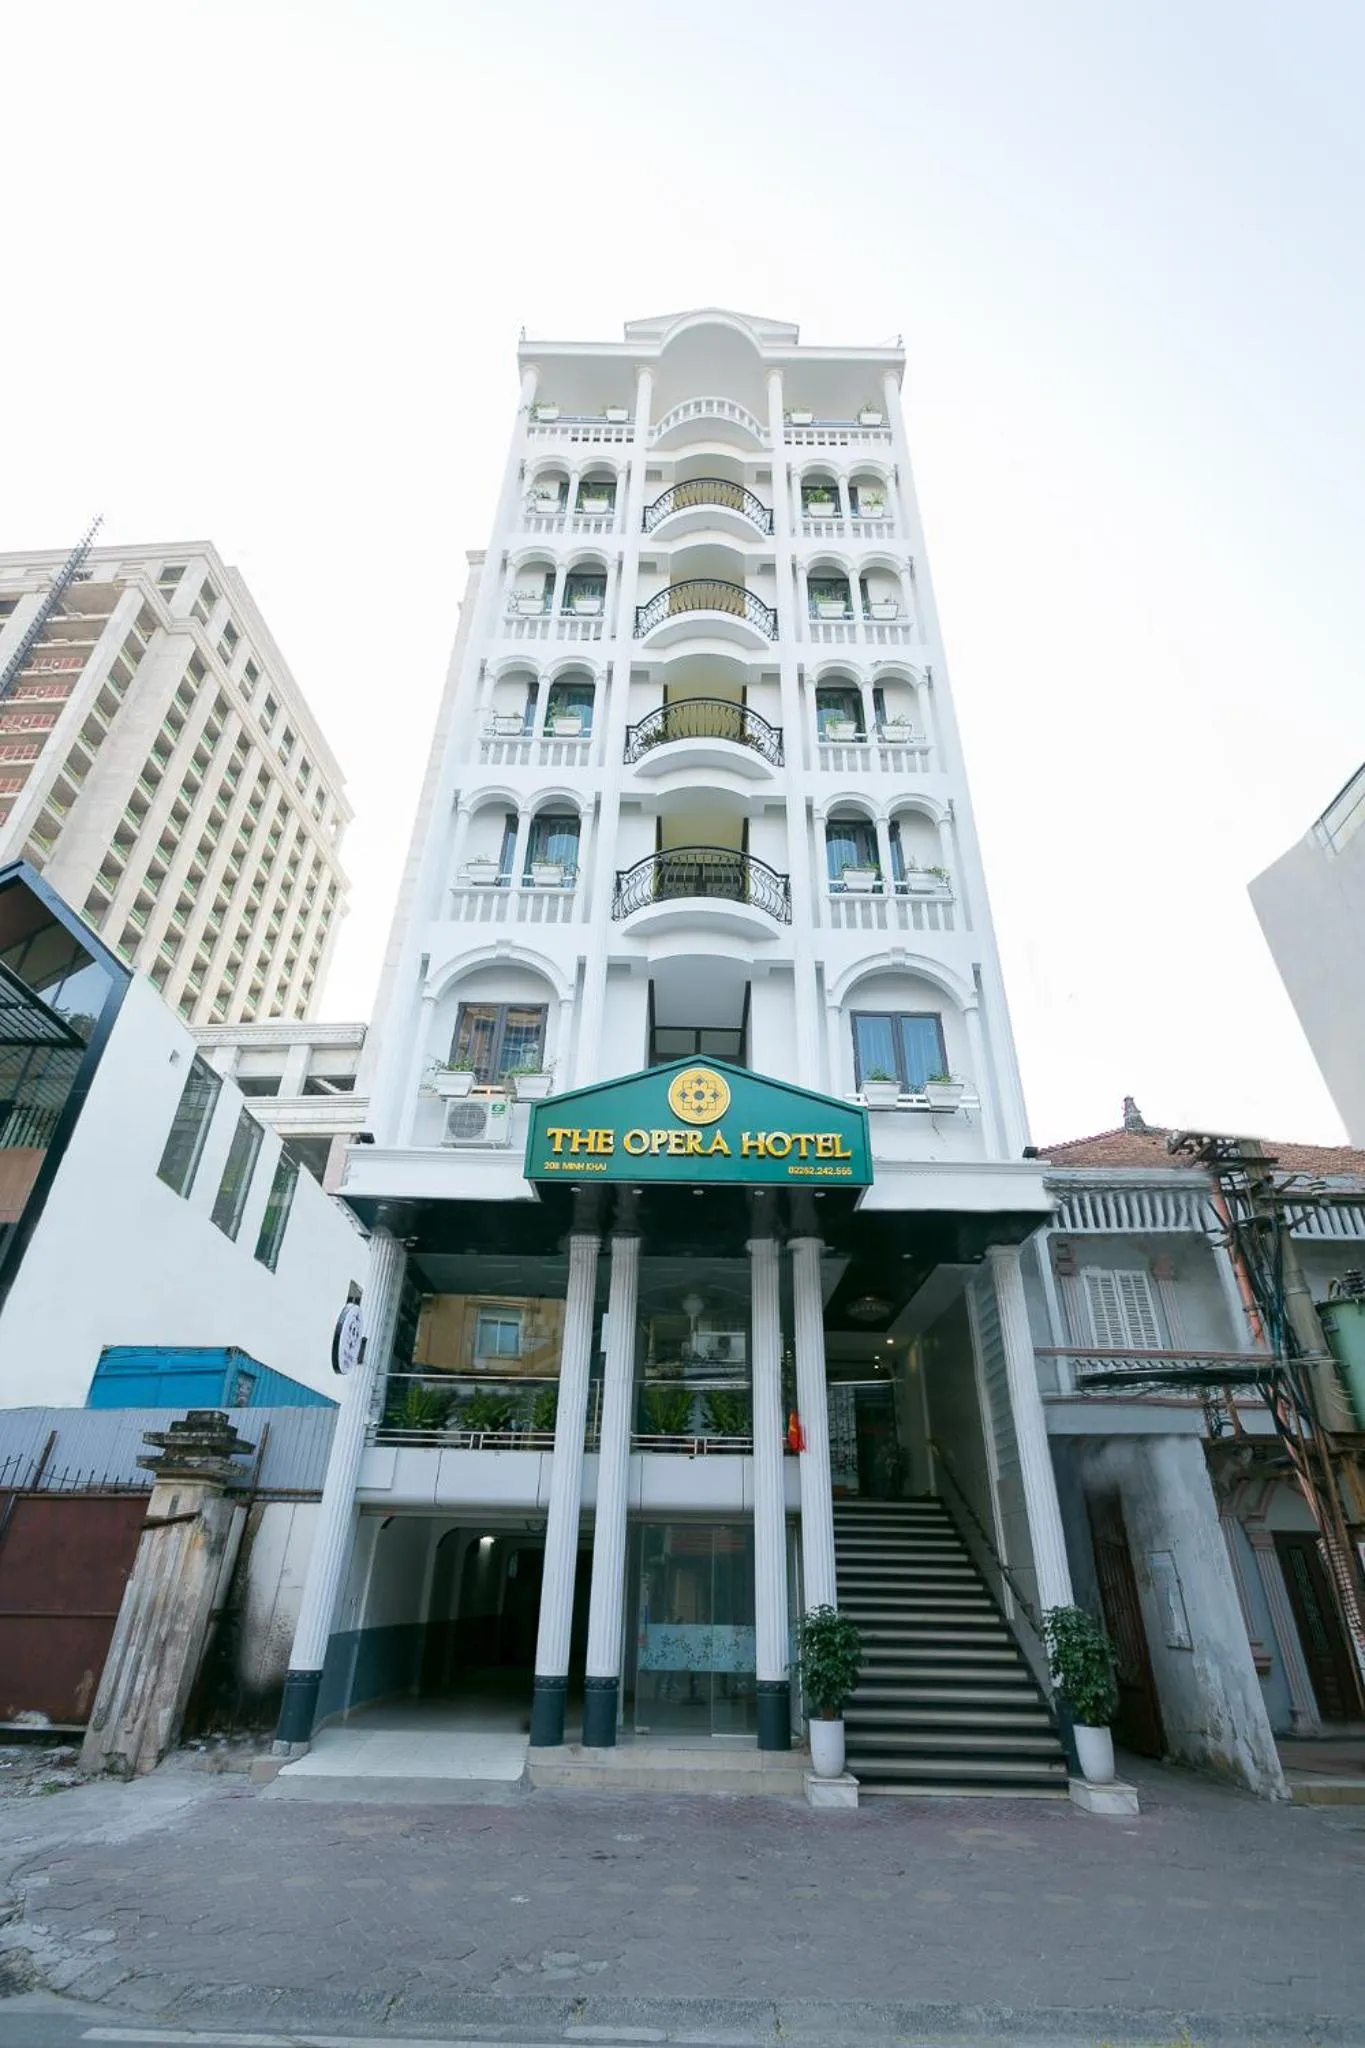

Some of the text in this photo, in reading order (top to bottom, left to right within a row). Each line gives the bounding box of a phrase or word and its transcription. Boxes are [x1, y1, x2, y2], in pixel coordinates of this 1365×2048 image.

[546, 1127, 852, 1158] THE OPERA HOTEL
[562, 1161, 585, 1171] MINH
[586, 1162, 607, 1172] KHAI
